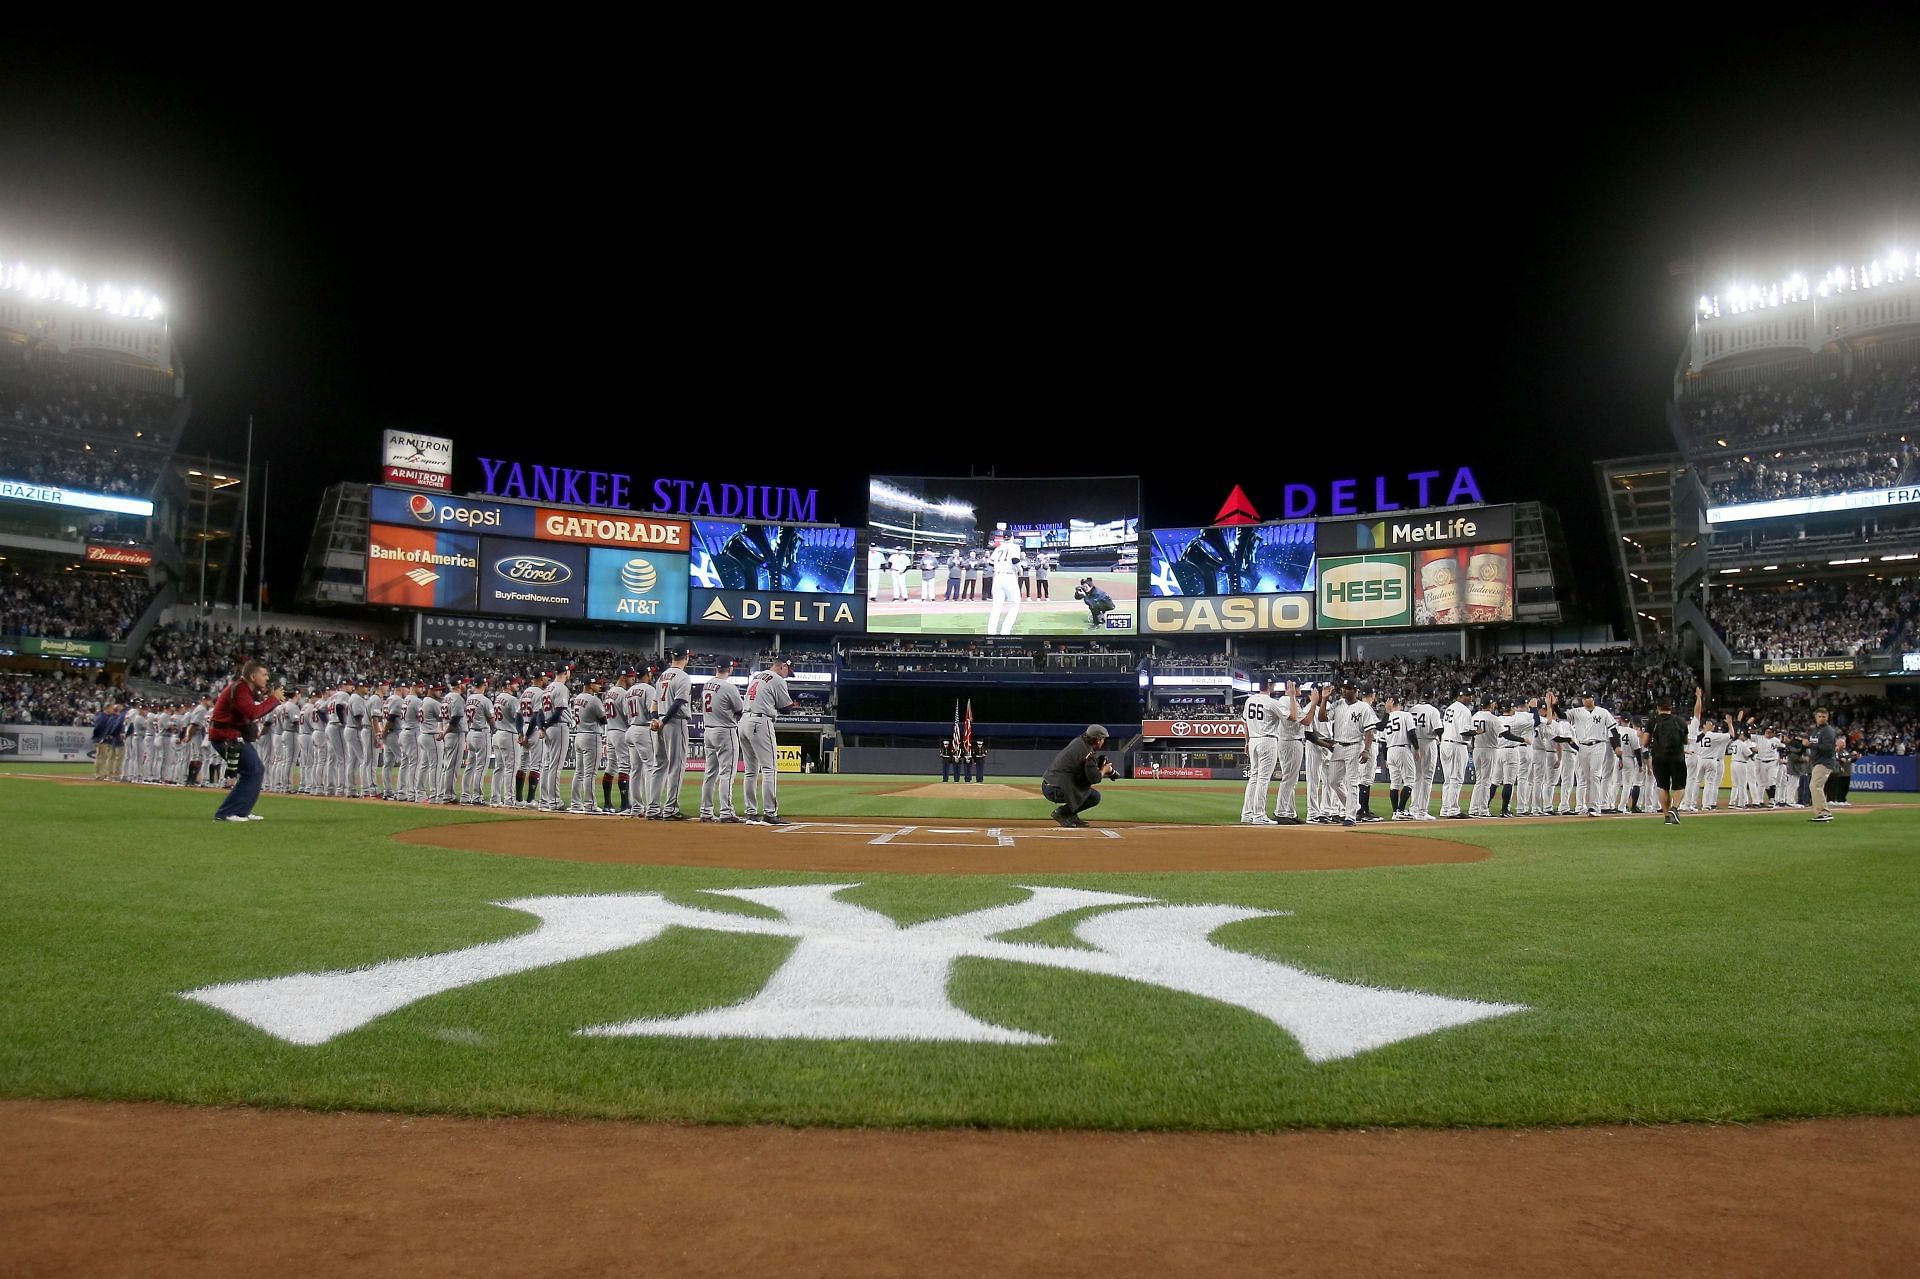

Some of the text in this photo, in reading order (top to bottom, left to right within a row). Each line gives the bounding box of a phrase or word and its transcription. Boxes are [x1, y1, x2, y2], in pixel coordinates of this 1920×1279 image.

[390, 435, 450, 452] ARMITRON
[391, 468, 445, 483] ARMITRON
[418, 479, 444, 488] WATCHES
[0, 483, 63, 503] RAZIER
[478, 457, 819, 522] YANKEE STADIUM
[1284, 466, 1483, 519] DELTA
[440, 506, 501, 527] pepsi
[546, 516, 682, 545] GATORADE
[1392, 518, 1478, 544] MetLife
[87, 547, 152, 564] Budweiser
[370, 544, 476, 568] Bank of America
[510, 557, 556, 582] Ford
[495, 590, 569, 605] BuyFordNow.com
[1326, 580, 1402, 604] HESS
[616, 598, 660, 616] AT&T
[742, 599, 855, 623] DELTA
[1147, 597, 1310, 632] CASIO
[1789, 661, 1854, 672] BUSINESS
[661, 682, 669, 702] 7
[747, 681, 759, 701] 4
[520, 702, 534, 718] 25
[704, 693, 713, 713] 2
[1248, 702, 1263, 720] 66
[1193, 723, 1246, 735] TOYOTA
[1386, 716, 1400, 735] 55
[1412, 713, 1426, 728] 54
